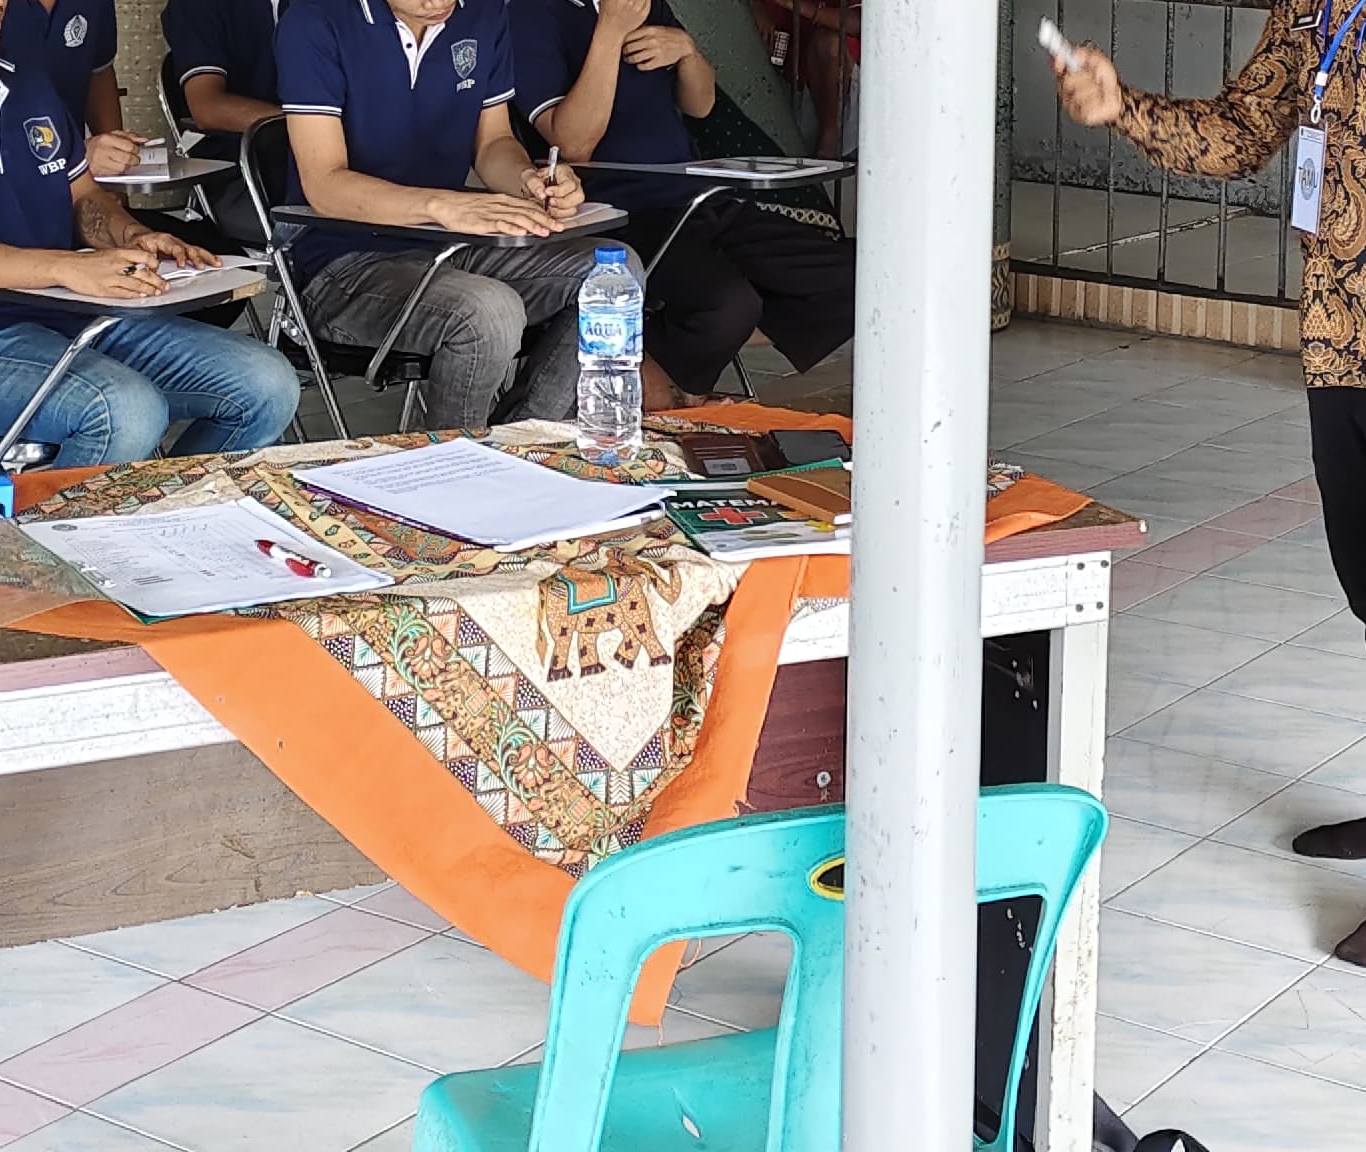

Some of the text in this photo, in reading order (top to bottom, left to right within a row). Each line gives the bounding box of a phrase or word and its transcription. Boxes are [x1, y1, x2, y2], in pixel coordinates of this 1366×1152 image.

[38, 158, 67, 176] WBP
[585, 322, 622, 337] AQUA
[670, 498, 778, 509] MATEM
